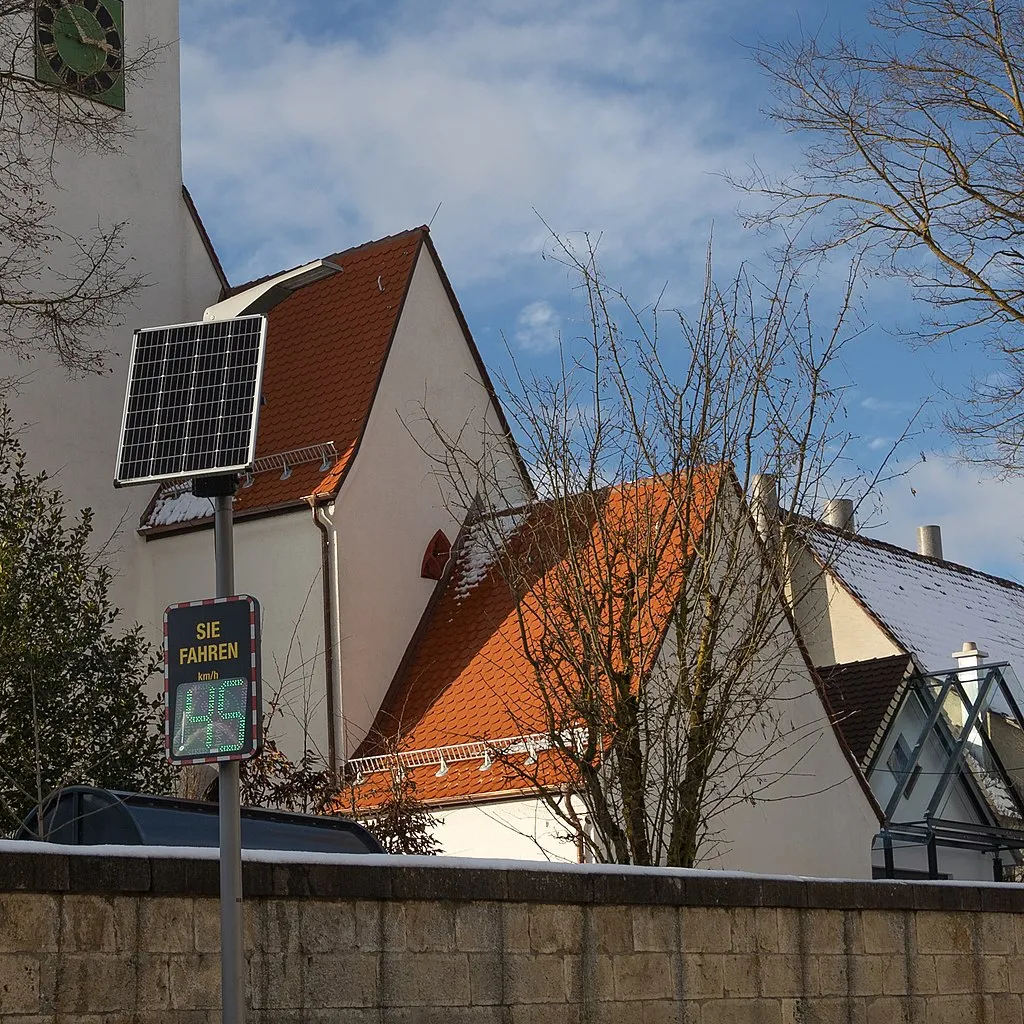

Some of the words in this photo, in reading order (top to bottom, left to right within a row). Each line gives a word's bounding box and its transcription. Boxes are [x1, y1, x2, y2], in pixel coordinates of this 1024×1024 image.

[196, 621, 220, 640] SIE
[179, 642, 238, 665] FAHREN
[197, 670, 219, 681] km/h
[185, 679, 246, 752] 45
